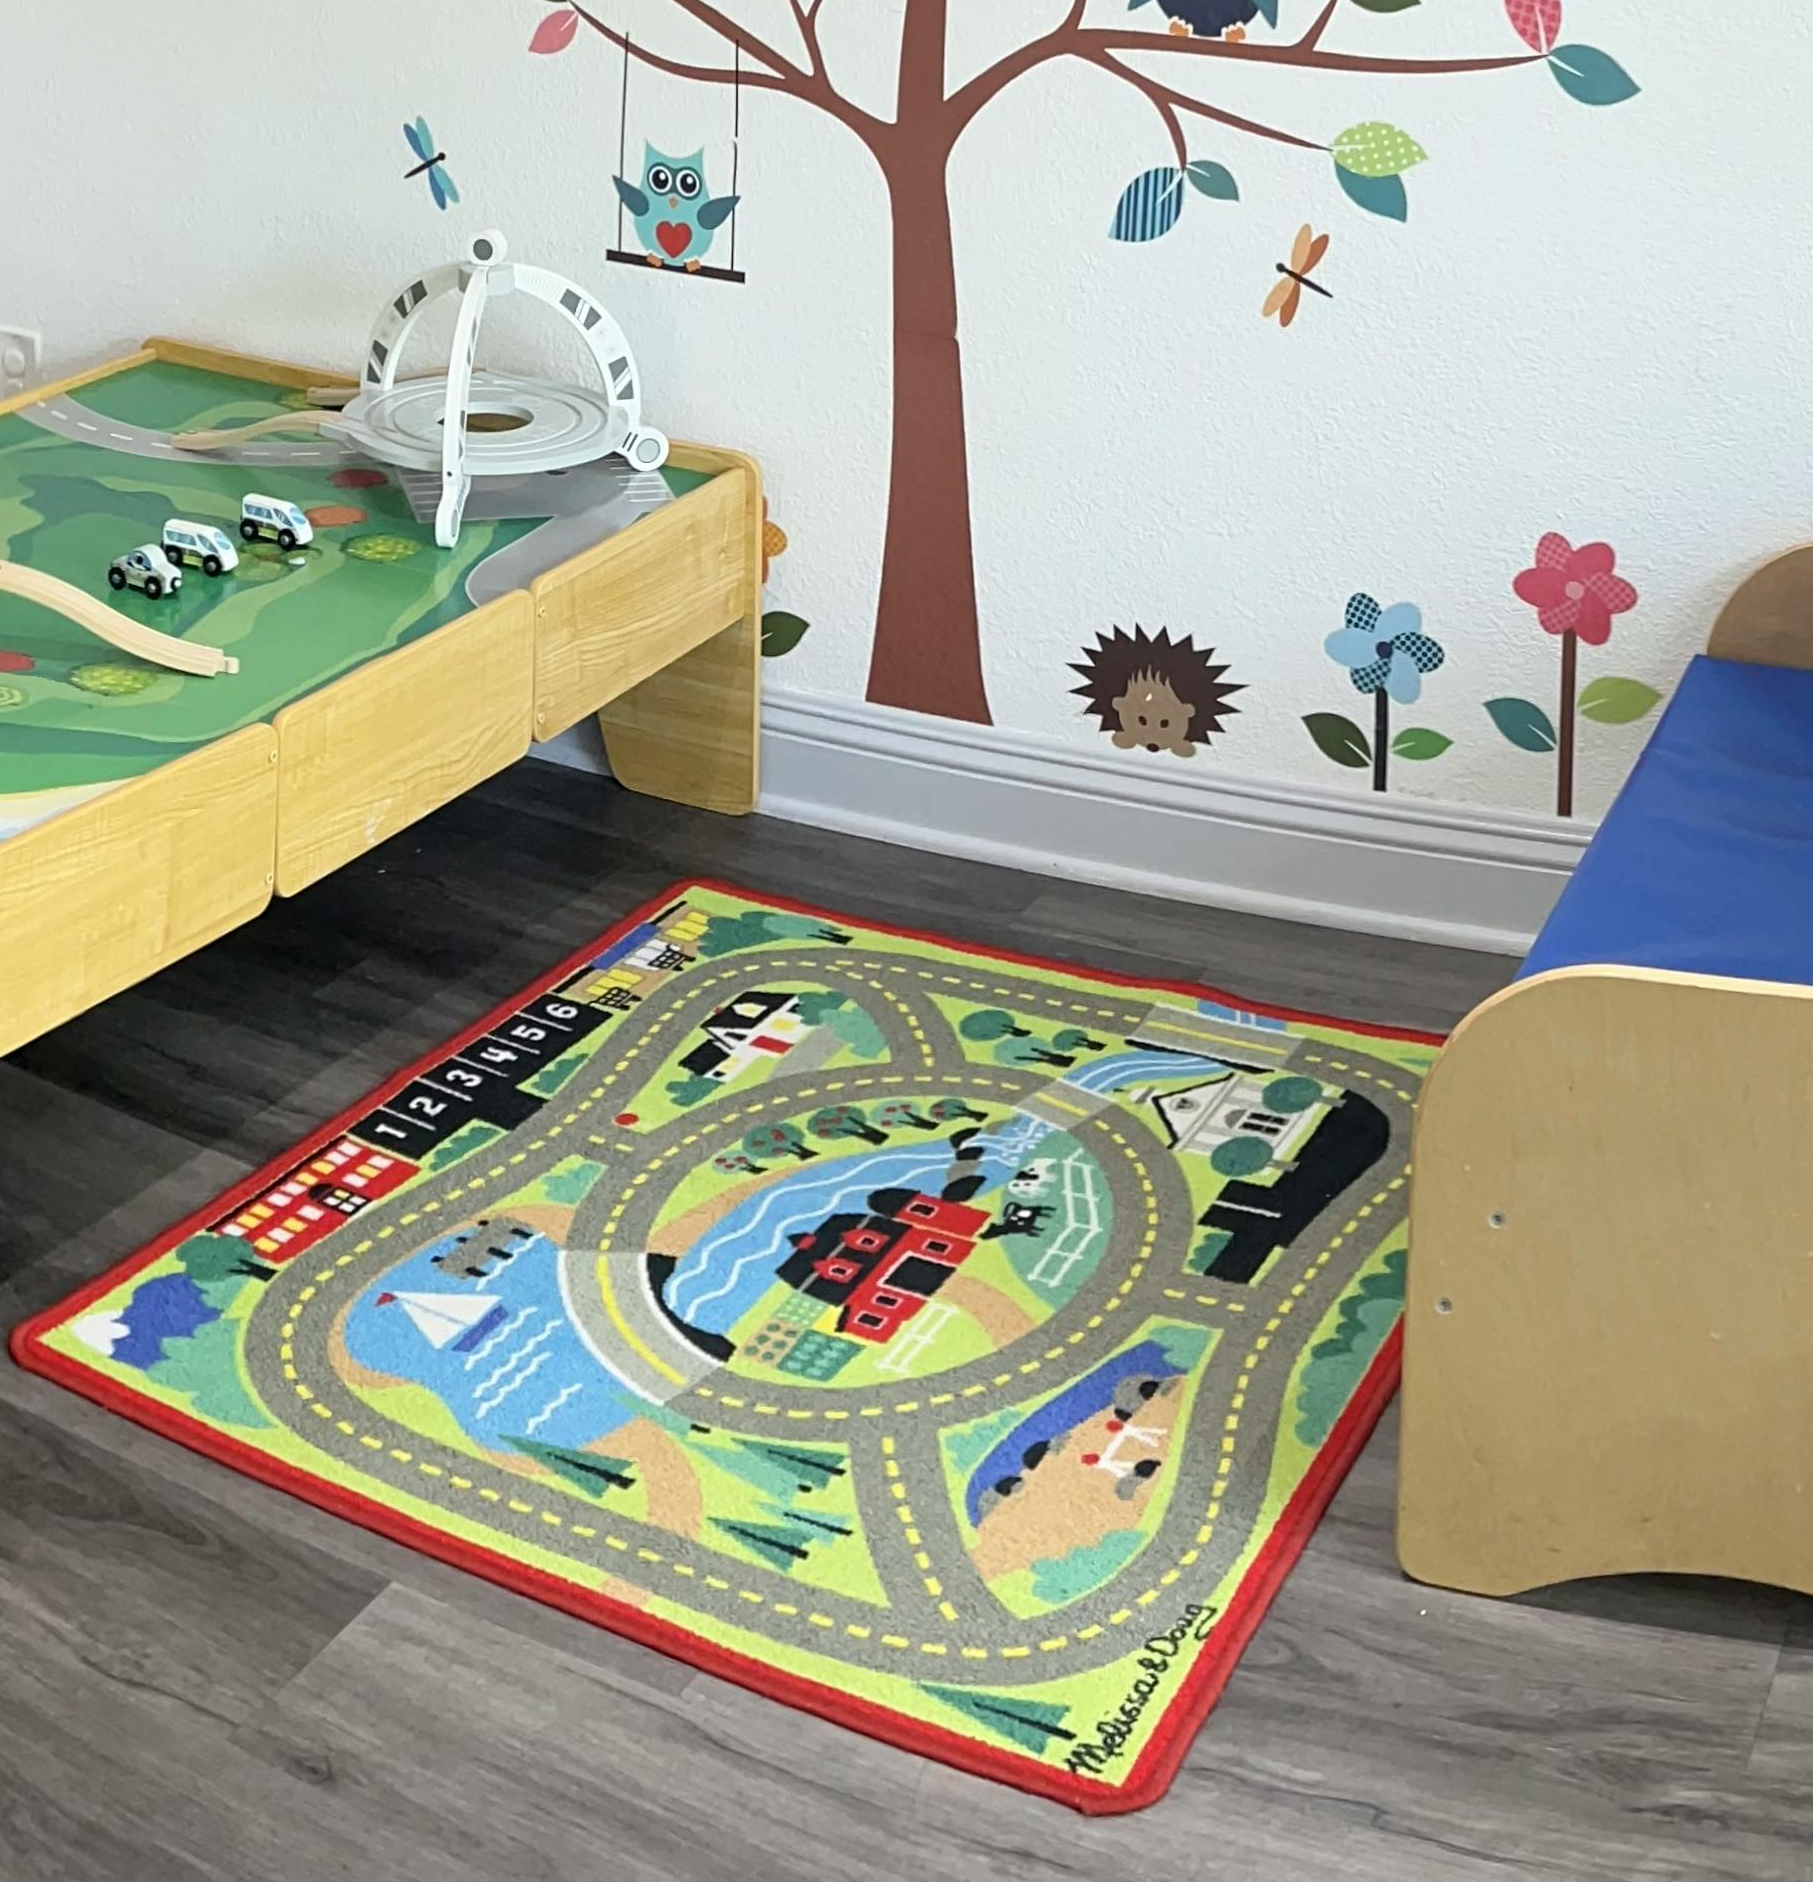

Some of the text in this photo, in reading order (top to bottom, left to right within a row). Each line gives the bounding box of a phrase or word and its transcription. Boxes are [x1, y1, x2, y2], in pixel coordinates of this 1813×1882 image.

[375, 1002, 579, 1141] 1 2 3 4 5 6
